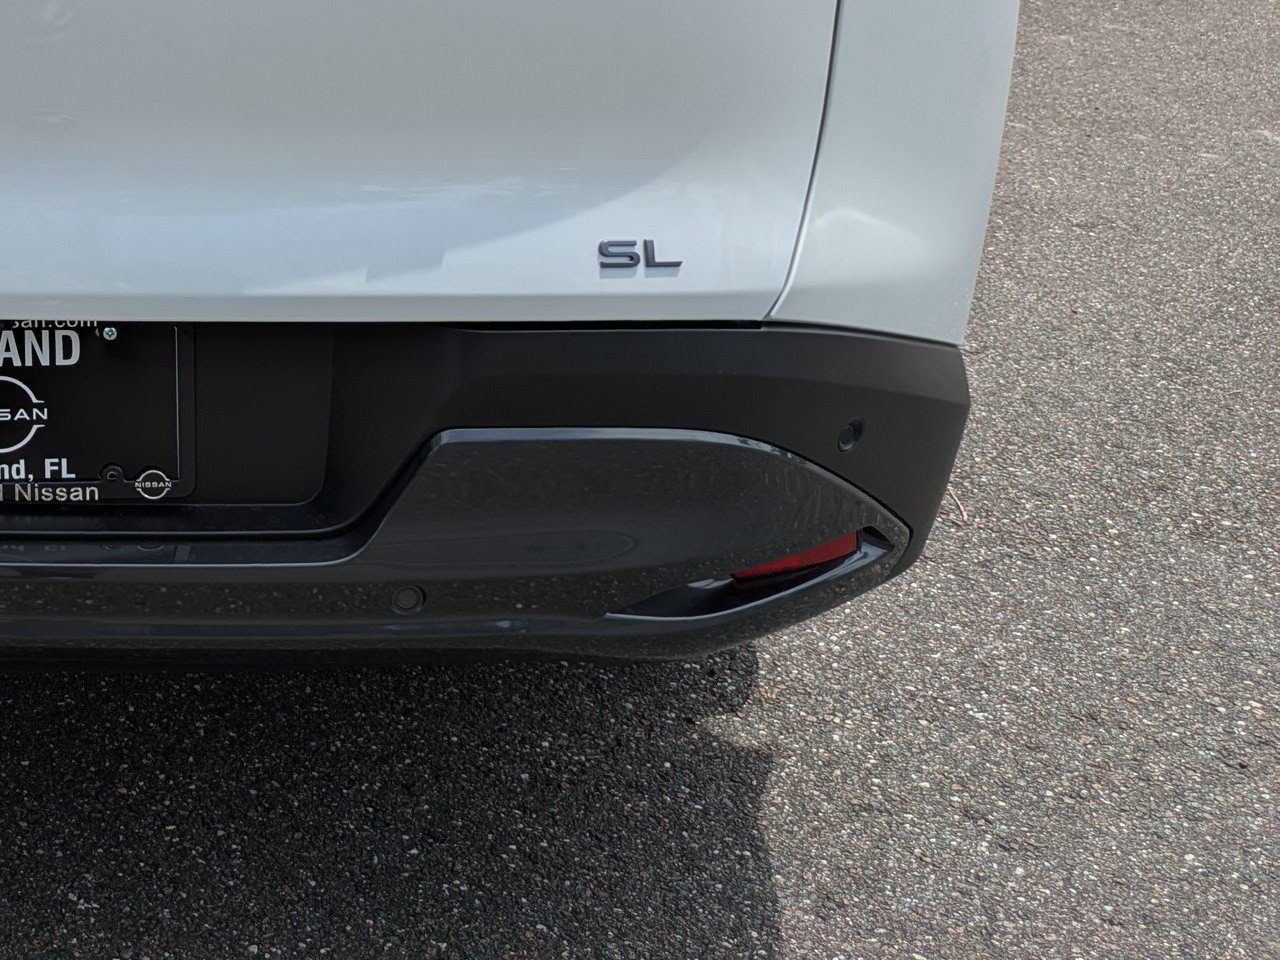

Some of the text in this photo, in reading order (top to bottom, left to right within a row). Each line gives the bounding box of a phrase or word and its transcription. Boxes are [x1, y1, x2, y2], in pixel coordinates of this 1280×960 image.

[598, 239, 683, 269] SL
[45, 458, 76, 480] FL
[15, 482, 99, 502] Nissan
[134, 480, 172, 489] NISSAN
